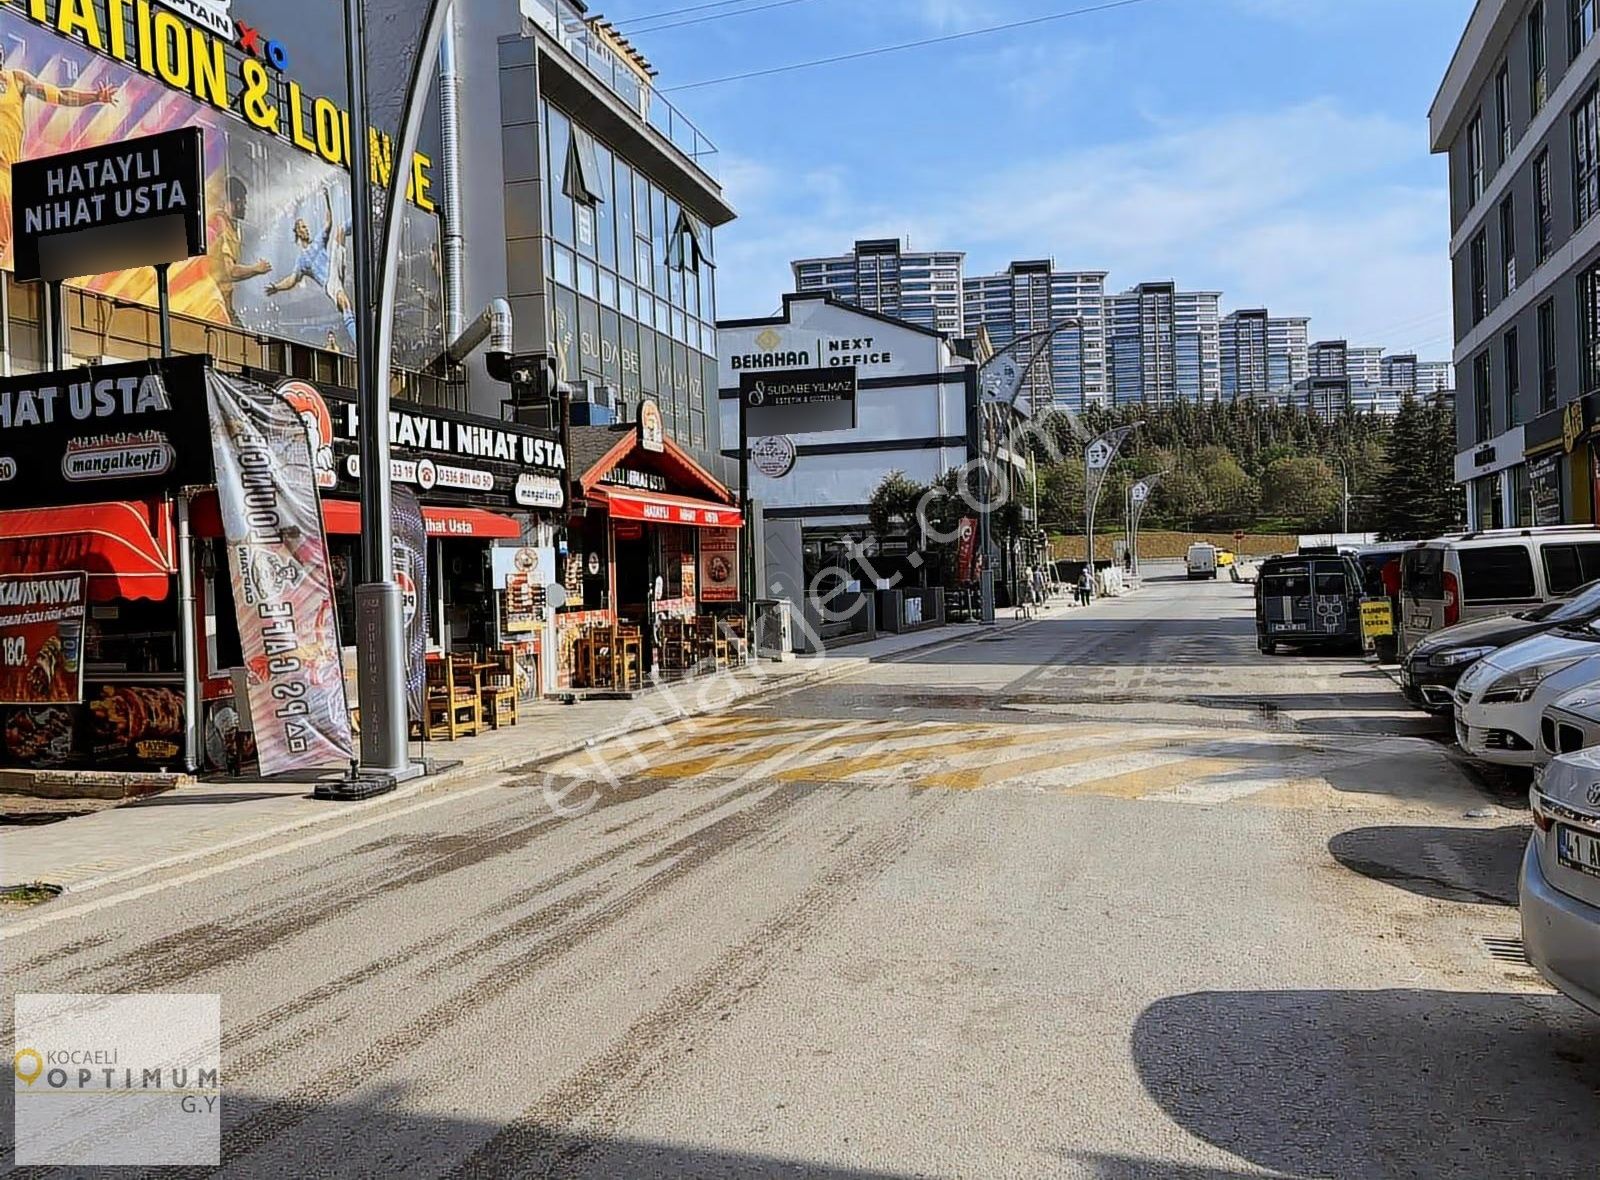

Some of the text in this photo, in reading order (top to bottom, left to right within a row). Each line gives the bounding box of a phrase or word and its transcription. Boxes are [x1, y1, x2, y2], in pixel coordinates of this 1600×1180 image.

[243, 58, 281, 133] &
[46, 149, 161, 197] HATAYLI
[114, 181, 188, 217] USTA
[829, 337, 875, 352] NEXT
[829, 352, 892, 367] OFFICE
[68, 374, 172, 420] USTA
[767, 380, 853, 395] SUDABE YILMAZ
[348, 403, 450, 450] HTAYLI
[522, 437, 567, 470] USTA
[448, 518, 473, 534] Usta
